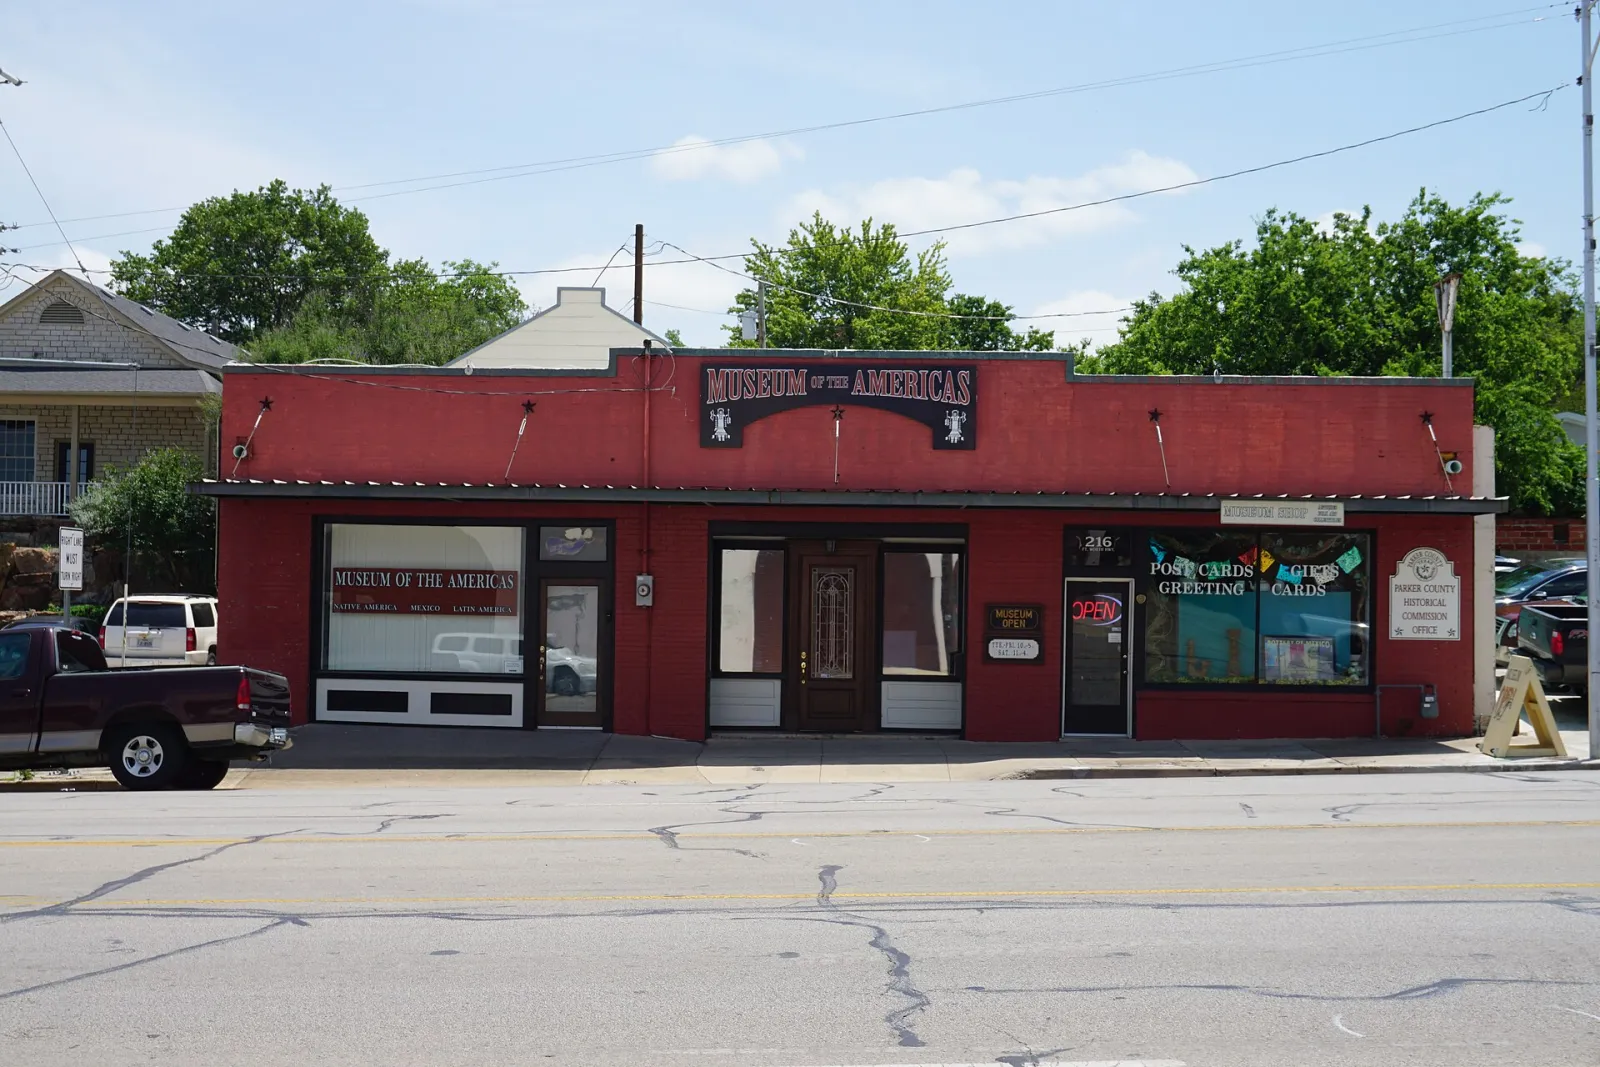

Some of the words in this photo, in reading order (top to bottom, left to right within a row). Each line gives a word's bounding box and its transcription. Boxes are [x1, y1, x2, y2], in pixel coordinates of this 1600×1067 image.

[706, 368, 808, 404] MUSEUM
[811, 376, 825, 389] OF
[826, 375, 849, 389] THE
[851, 369, 971, 405] AMERICAS
[1223, 505, 1274, 518] MUSEUM
[1278, 507, 1308, 519] SHOP
[61, 536, 73, 546] RIGHT
[73, 537, 83, 546] LANE
[1085, 536, 1112, 547] 216
[65, 553, 78, 564] MUST
[1407, 551, 1423, 568] PARKER
[1424, 550, 1444, 567] COUNTY
[1151, 562, 1190, 576] POST
[1198, 563, 1254, 578] CARDS
[1290, 564, 1340, 577] GIFTS
[61, 571, 71, 580] TURN
[71, 571, 82, 581] RIGHT
[335, 571, 391, 587] MUSEUM
[396, 572, 413, 587] OF
[416, 572, 443, 588] THE
[447, 573, 514, 590] AMERICAS
[1158, 581, 1245, 596] GREETING
[1271, 583, 1327, 597] CARDS
[1394, 584, 1421, 593] PARKER
[1423, 584, 1456, 593] COUNTY
[363, 603, 398, 611] AMERICA
[1403, 598, 1447, 607] HISTORICAL
[410, 604, 441, 612] MEXICO
[453, 605, 476, 613] LATIN
[1072, 601, 1117, 620] OPEN
[995, 609, 1033, 619] MUSEUM
[1401, 612, 1448, 620] COMMISSION
[1002, 619, 1026, 628] OPEN
[1412, 626, 1438, 634] OFFICE
[1305, 640, 1330, 648] MEXICO
